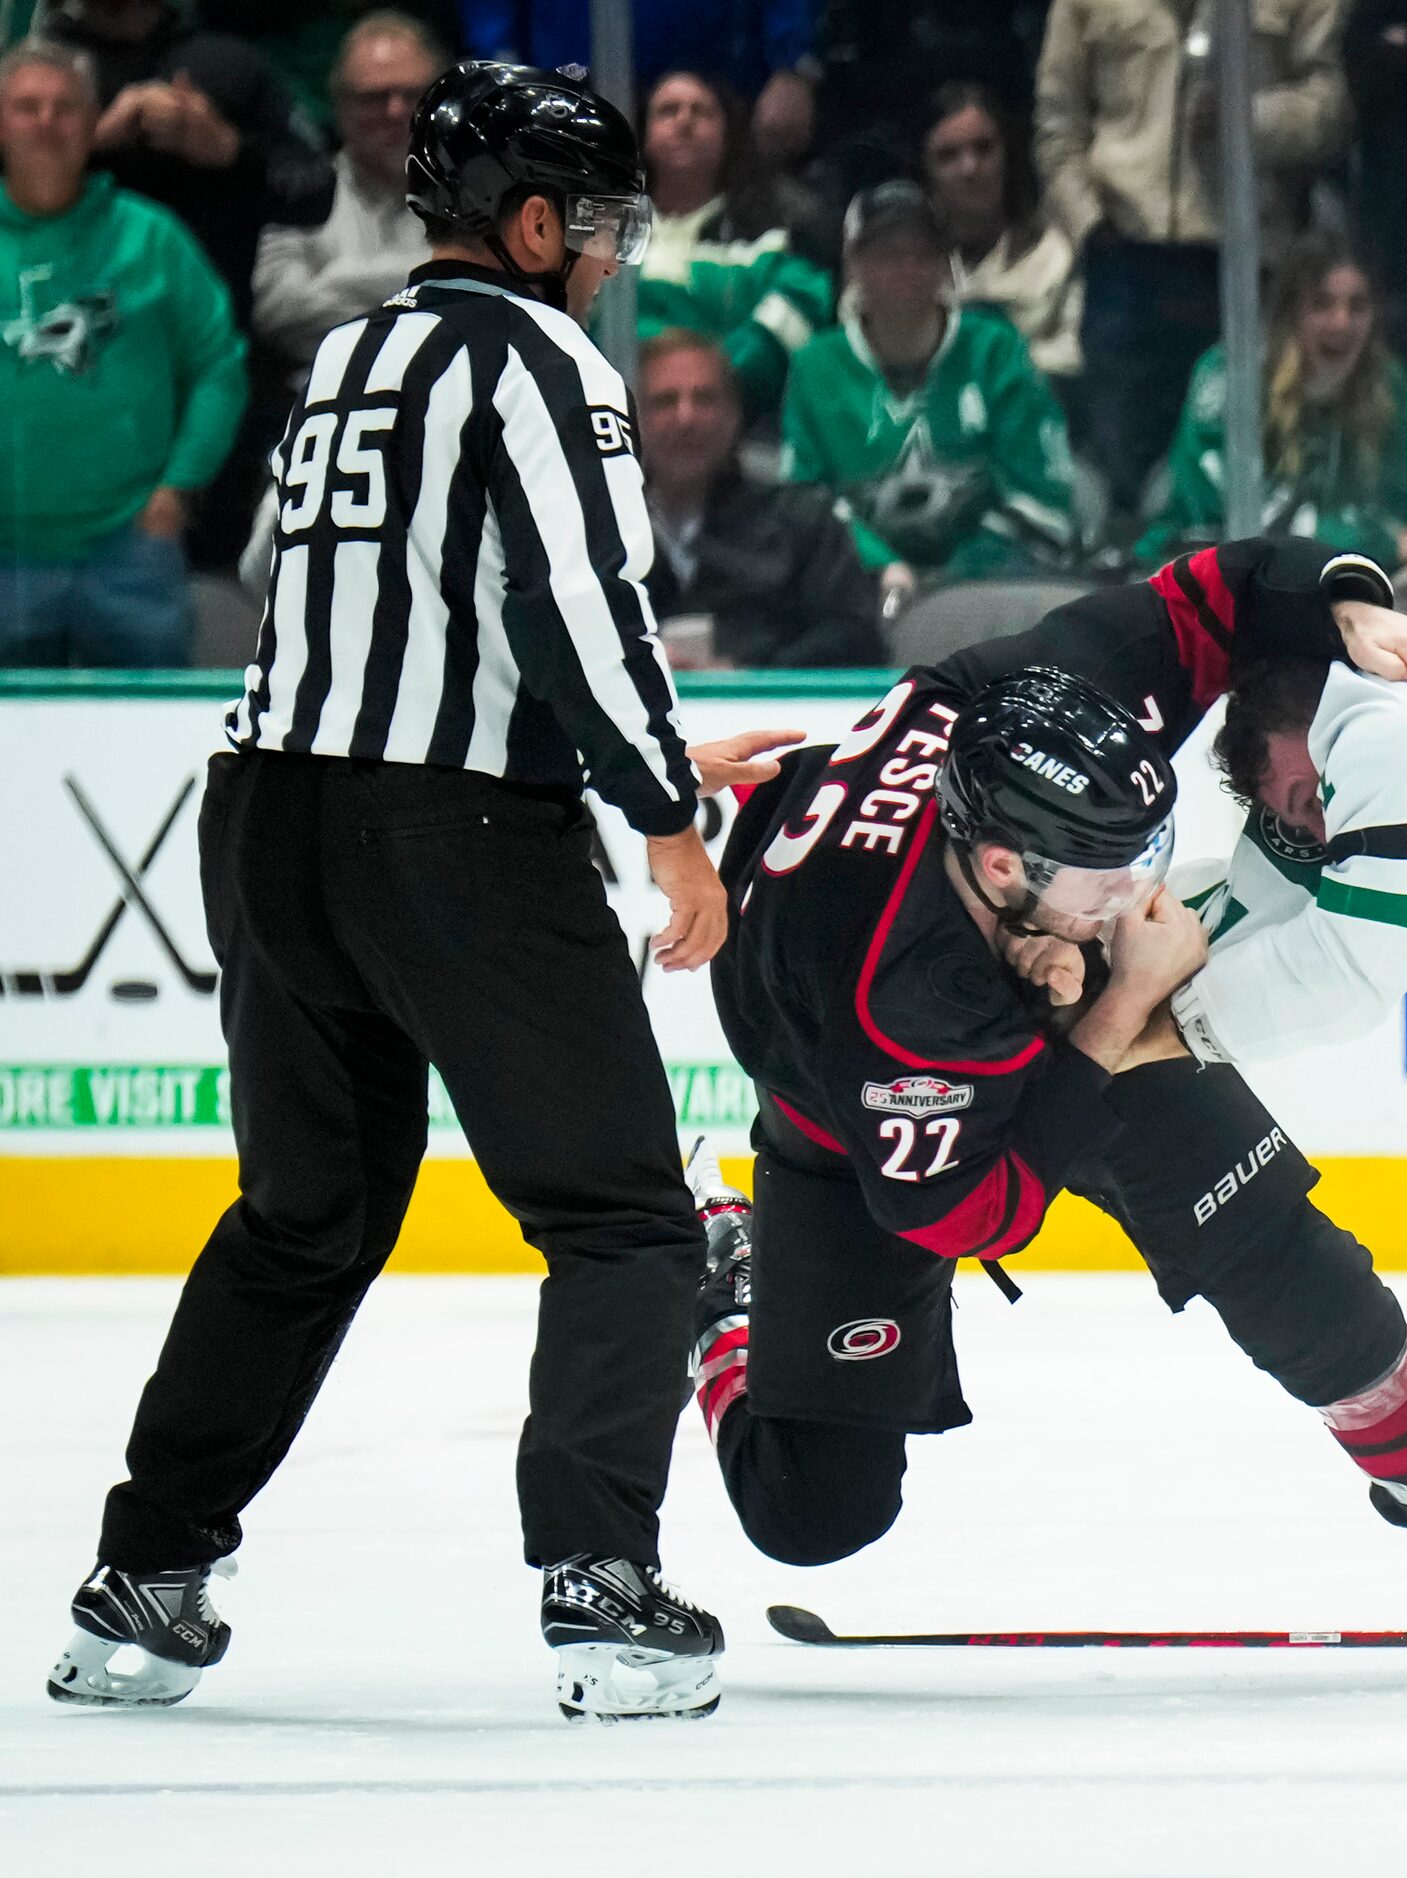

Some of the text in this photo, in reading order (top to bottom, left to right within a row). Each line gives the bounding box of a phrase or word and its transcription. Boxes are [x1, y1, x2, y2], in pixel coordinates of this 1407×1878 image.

[590, 410, 633, 456] 95
[281, 407, 398, 535] 95
[1010, 742, 1090, 795] CANES
[1130, 758, 1165, 807] 22
[90, 1070, 201, 1120] VISIT
[889, 1091, 967, 1107] ANNIVERSARY
[879, 1117, 961, 1182] 22
[1193, 1126, 1287, 1227] BAUER
[172, 1622, 204, 1649] CCM
[653, 1612, 686, 1636] 95
